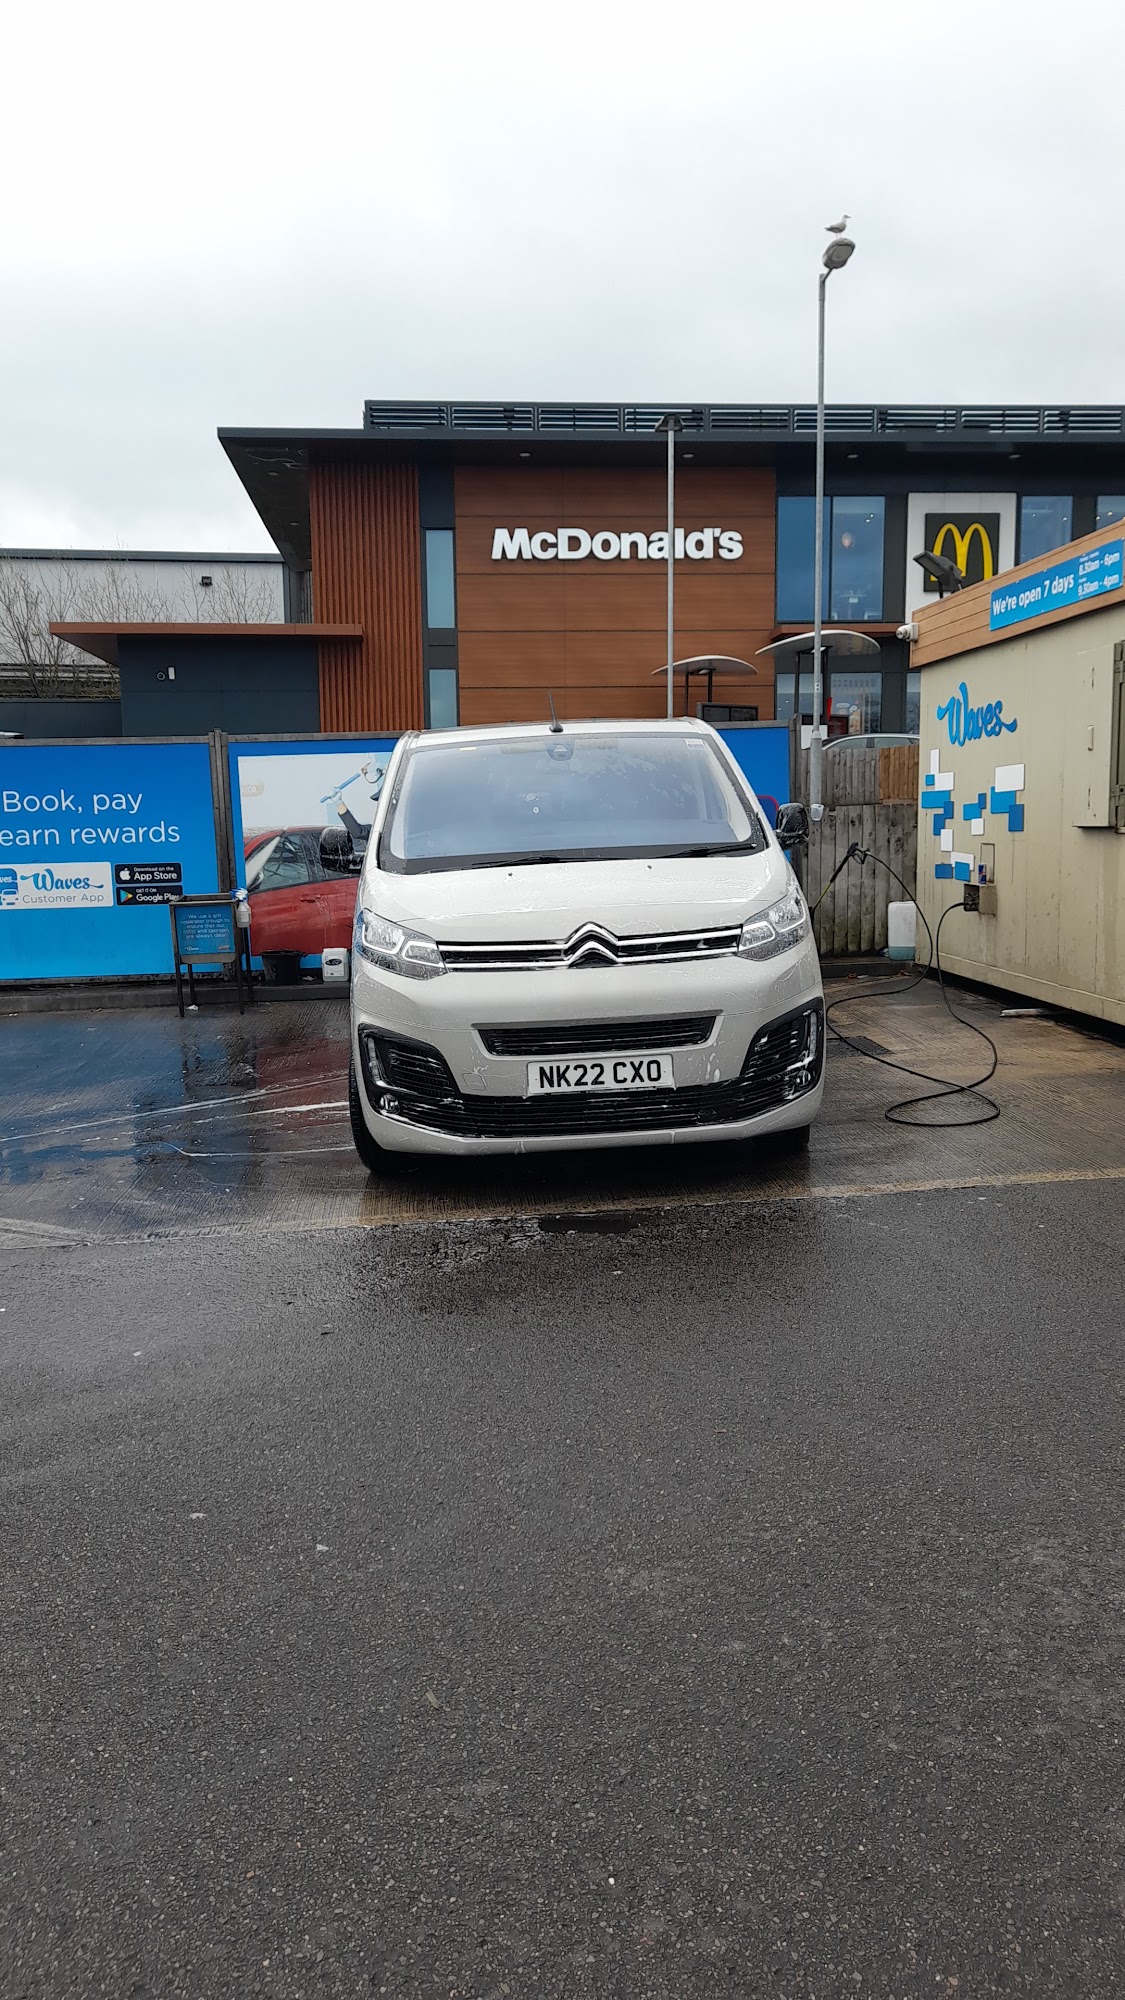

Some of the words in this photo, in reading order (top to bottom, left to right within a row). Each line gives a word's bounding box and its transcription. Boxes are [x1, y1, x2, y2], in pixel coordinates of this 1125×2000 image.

[491, 527, 744, 560] McDonald's
[1104, 552, 1120, 566] 6pm
[1103, 574, 1119, 587] 4pm
[992, 597, 1017, 615] We're
[1019, 587, 1041, 607] open
[1043, 580, 1050, 597] 7
[1052, 573, 1074, 595] days
[937, 682, 1017, 746] Waves
[2, 789, 83, 814] Book,
[93, 793, 143, 815] pay
[0, 828, 60, 846] earn
[71, 820, 180, 845] rewards
[20, 868, 104, 891] Waves
[134, 872, 152, 881] App
[154, 871, 178, 880] Store
[22, 894, 76, 904] Customer
[81, 893, 104, 905] App
[136, 893, 163, 902] Google
[538, 1063, 605, 1089] NK22
[612, 1059, 662, 1084] CXO
